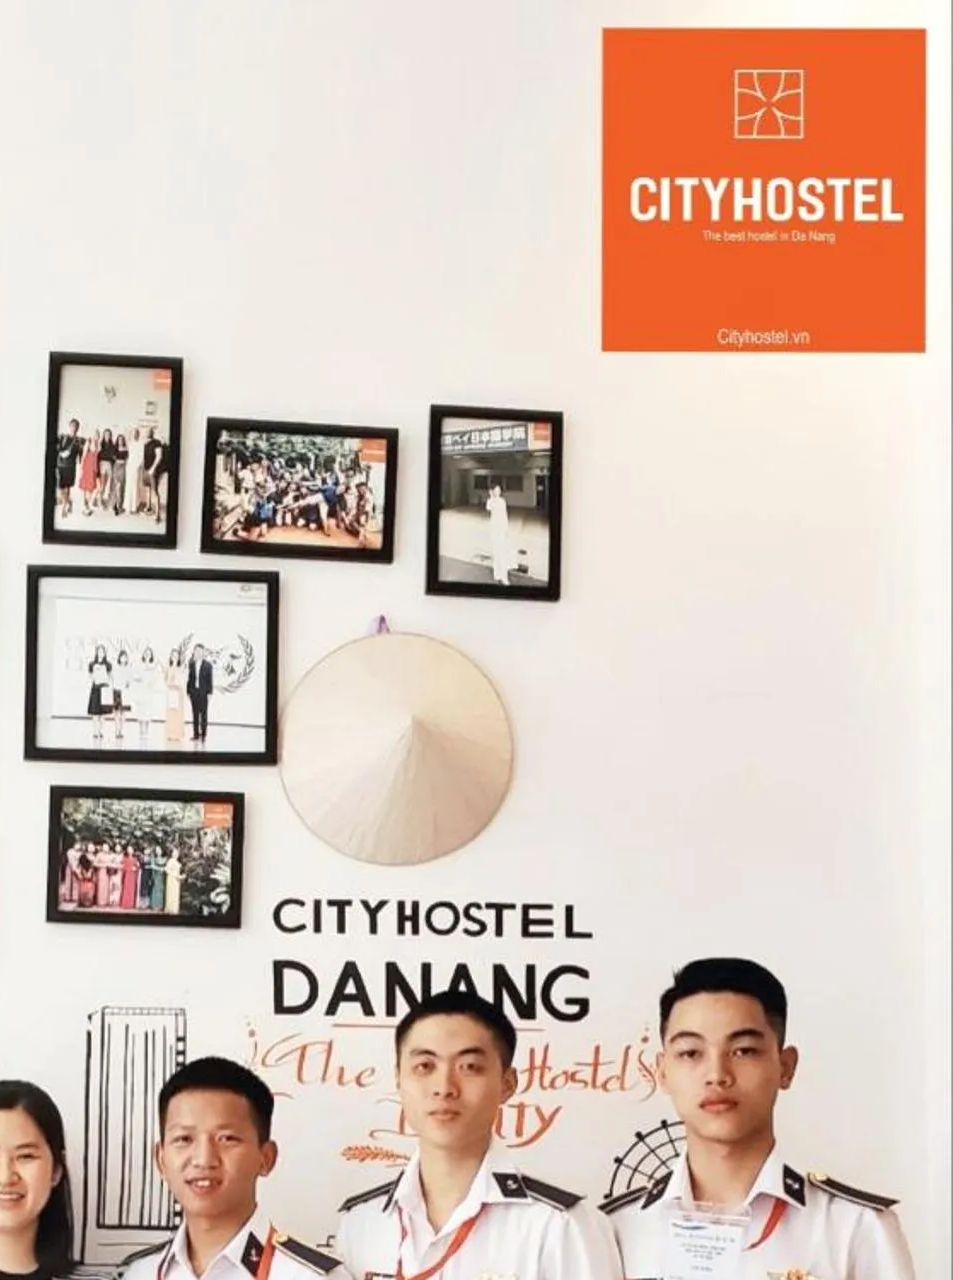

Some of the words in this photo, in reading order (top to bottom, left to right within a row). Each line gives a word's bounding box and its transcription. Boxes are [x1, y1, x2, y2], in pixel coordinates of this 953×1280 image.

[272, 897, 593, 939] CITYHOSTEL
[272, 959, 591, 1023] DANANG
[262, 1034, 377, 1088] The
